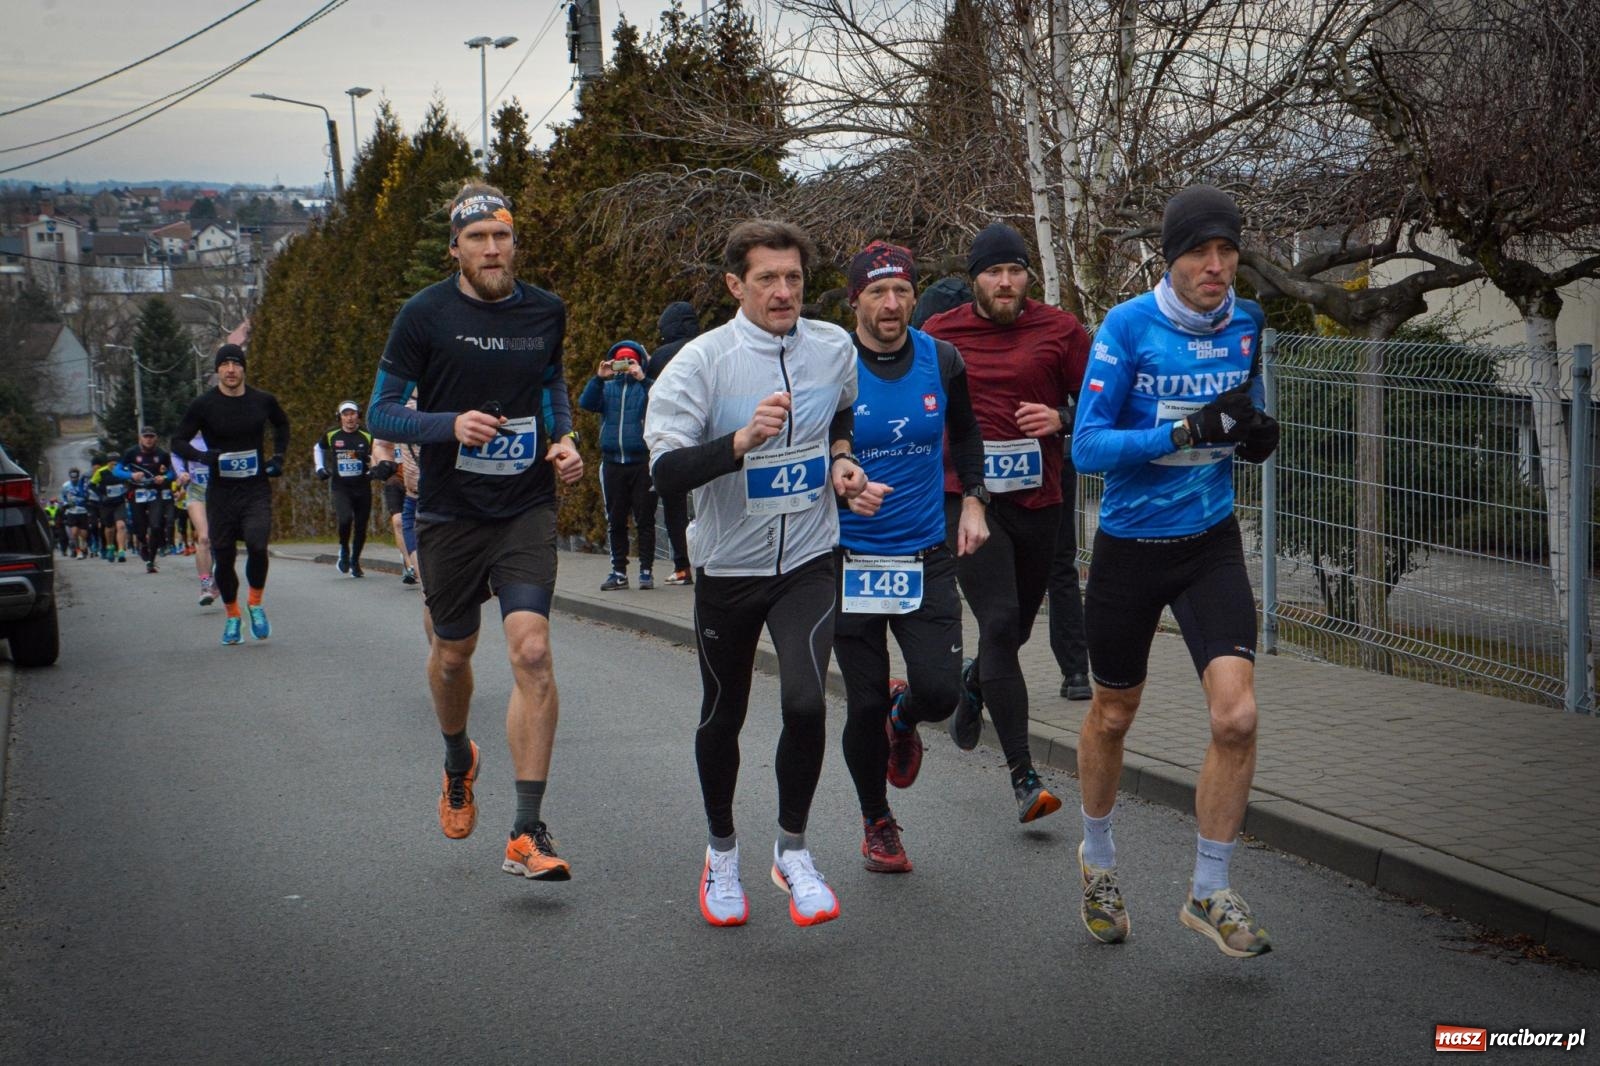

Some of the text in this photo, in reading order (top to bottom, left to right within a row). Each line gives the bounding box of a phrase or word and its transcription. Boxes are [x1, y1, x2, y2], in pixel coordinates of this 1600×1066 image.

[460, 202, 488, 219] 2024
[476, 434, 525, 459] 126
[907, 442, 932, 455] Żory
[231, 459, 248, 470] 93
[984, 454, 1031, 477] 194
[771, 464, 809, 493] 42
[859, 572, 910, 596] 148
